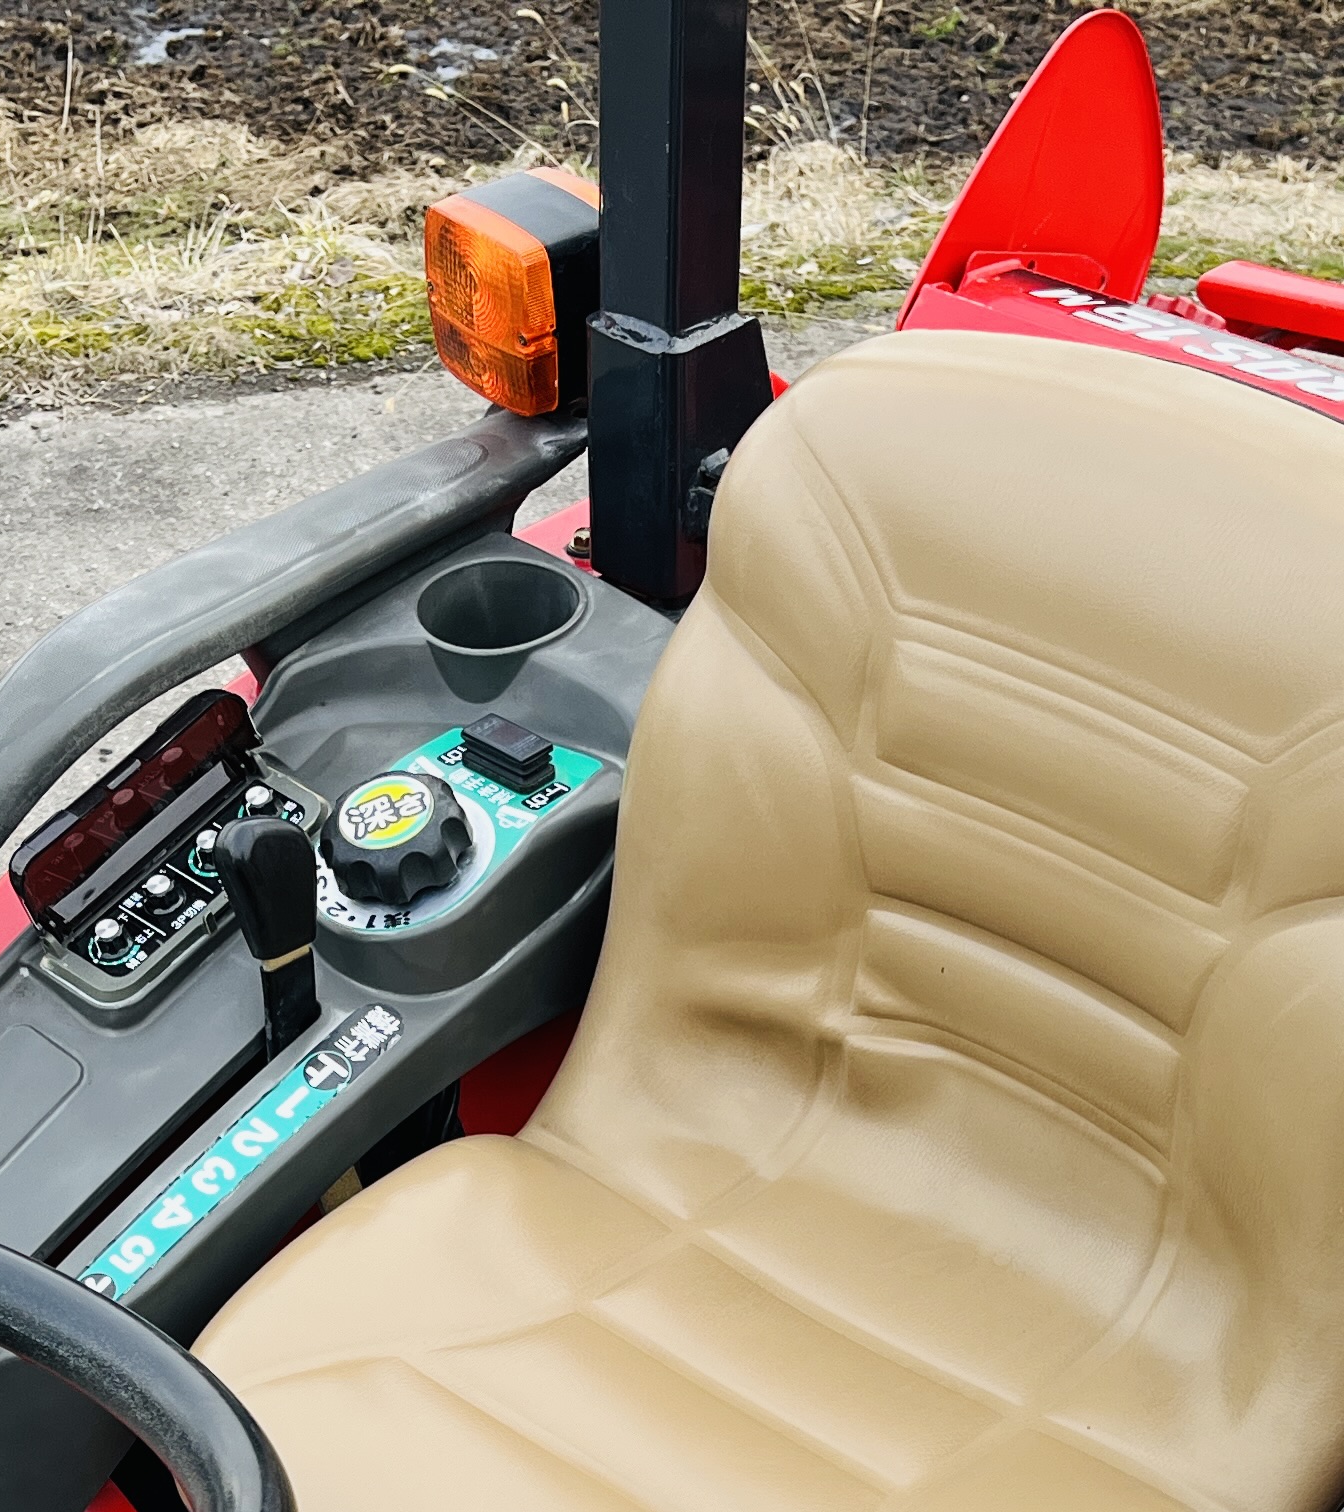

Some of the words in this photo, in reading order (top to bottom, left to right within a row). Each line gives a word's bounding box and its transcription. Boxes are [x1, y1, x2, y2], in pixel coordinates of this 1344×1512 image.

[525, 783, 570, 809] 右上
[346, 792, 427, 840] 深さ
[326, 901, 348, 917] 2
[365, 914, 377, 929] 1
[333, 1004, 401, 1063] 作業機
[305, 1052, 350, 1088] 上
[275, 1086, 310, 1119] 1
[231, 1118, 280, 1157] 2
[191, 1156, 236, 1195] 3
[151, 1194, 194, 1229] 4
[108, 1235, 156, 1274] 5
